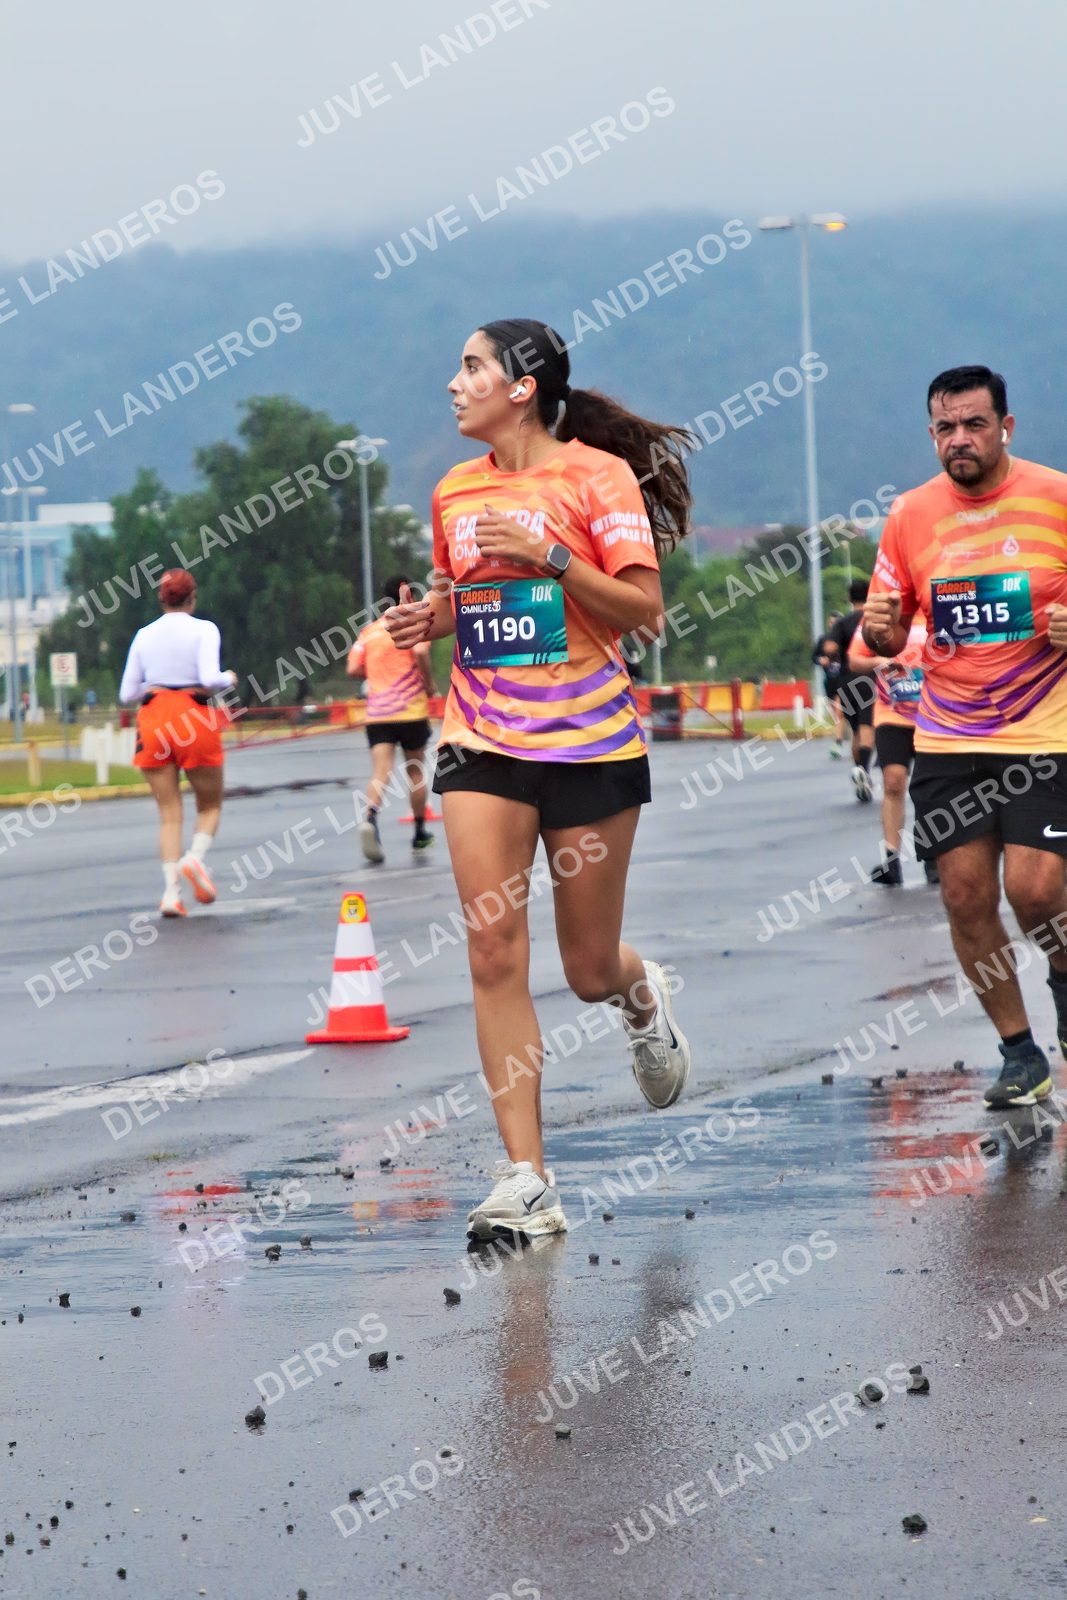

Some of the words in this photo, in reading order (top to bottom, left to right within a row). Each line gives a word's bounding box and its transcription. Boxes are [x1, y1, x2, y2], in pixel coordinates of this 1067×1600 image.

[936, 582, 976, 594] CARRERA
[1002, 578, 1020, 592] 10K
[461, 589, 501, 604] CARRERA
[532, 585, 552, 602] 10K
[937, 593, 968, 602] OMNILIFE
[461, 603, 492, 614] OMNILIFE
[952, 602, 1010, 624] 1315
[473, 616, 536, 642] 1190
